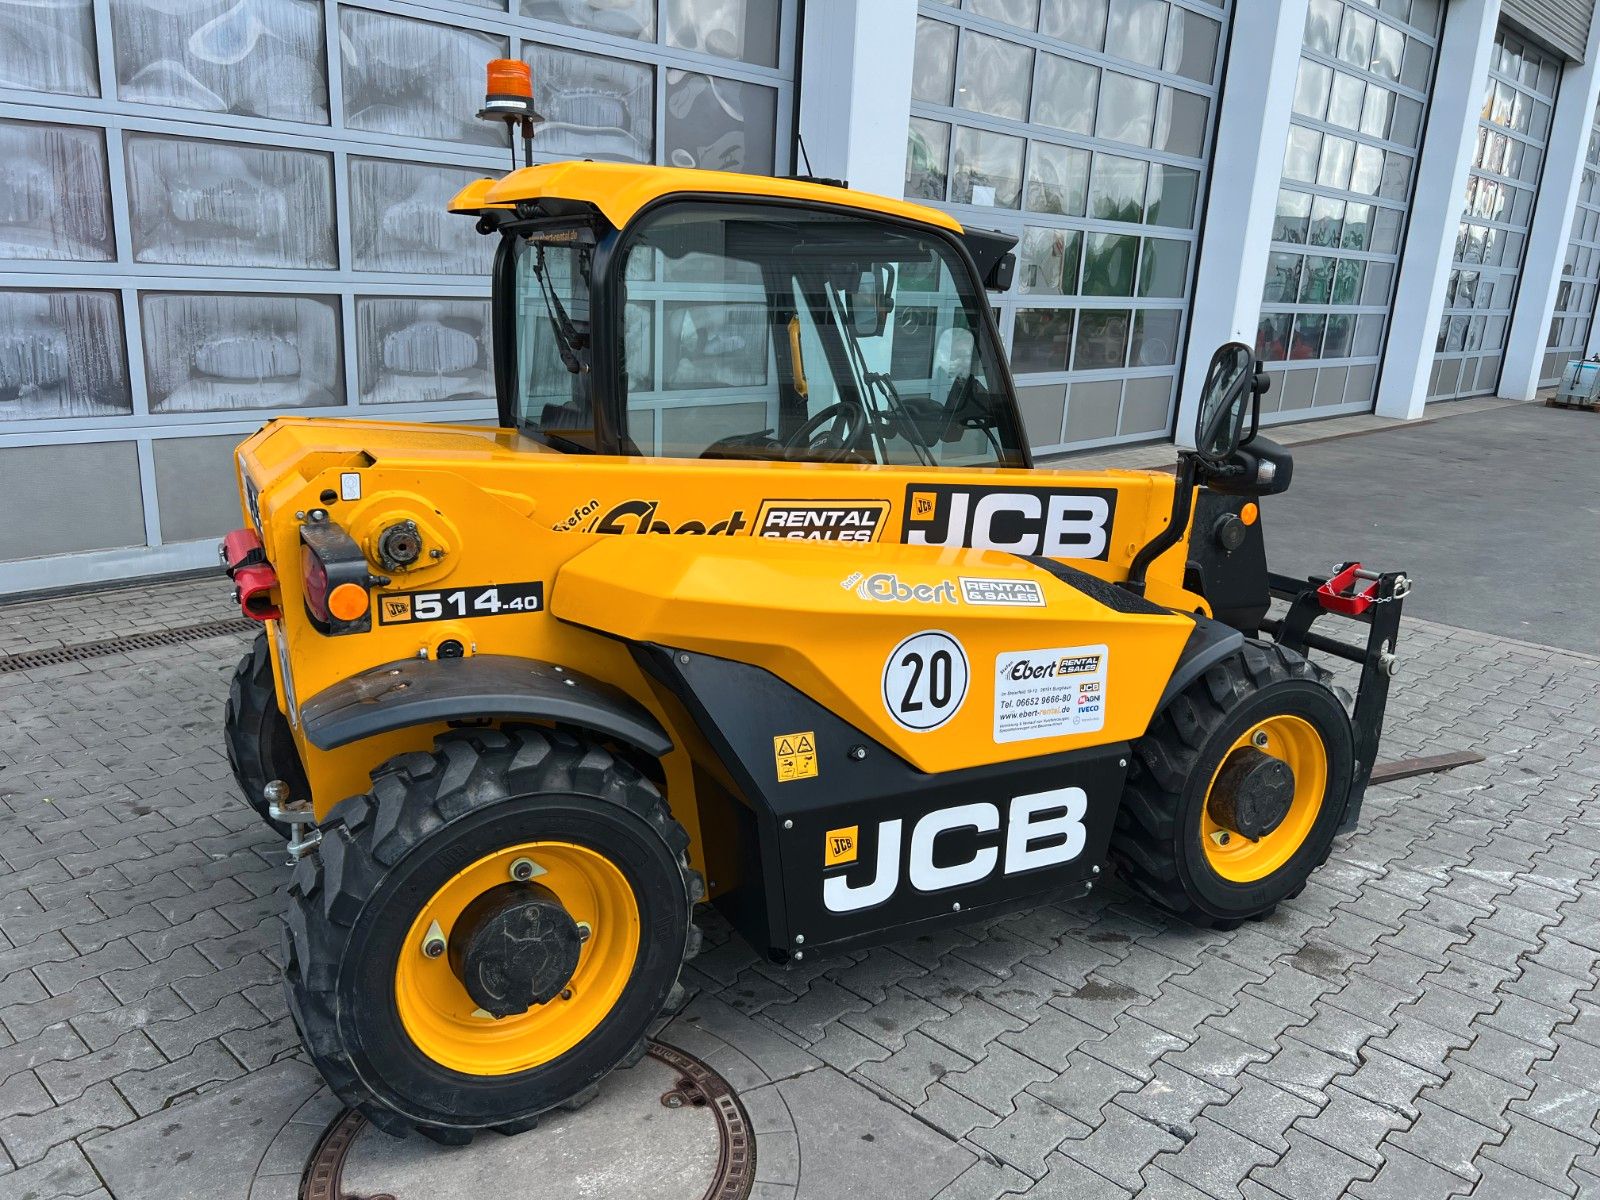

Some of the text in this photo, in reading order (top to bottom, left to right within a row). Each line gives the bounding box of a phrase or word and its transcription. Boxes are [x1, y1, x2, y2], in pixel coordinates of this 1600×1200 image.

[917, 498, 933, 515] JCB
[765, 511, 876, 527] RENTAL
[907, 492, 1109, 559] JCB
[867, 574, 957, 603] Ebert
[967, 581, 1037, 593] RENTAL
[968, 591, 1039, 602] & SALES
[389, 603, 408, 616] JCB
[1060, 657, 1098, 667] RENTAL
[1067, 664, 1097, 672] SALES
[1011, 660, 1057, 681] Ebert
[900, 650, 952, 713] 20
[1080, 683, 1099, 692] JCB
[1000, 693, 1072, 709] Tel. 06652 9666-80
[1078, 704, 1099, 714] IVECO
[823, 786, 1088, 913] JCB
[833, 837, 853, 855] JCB
